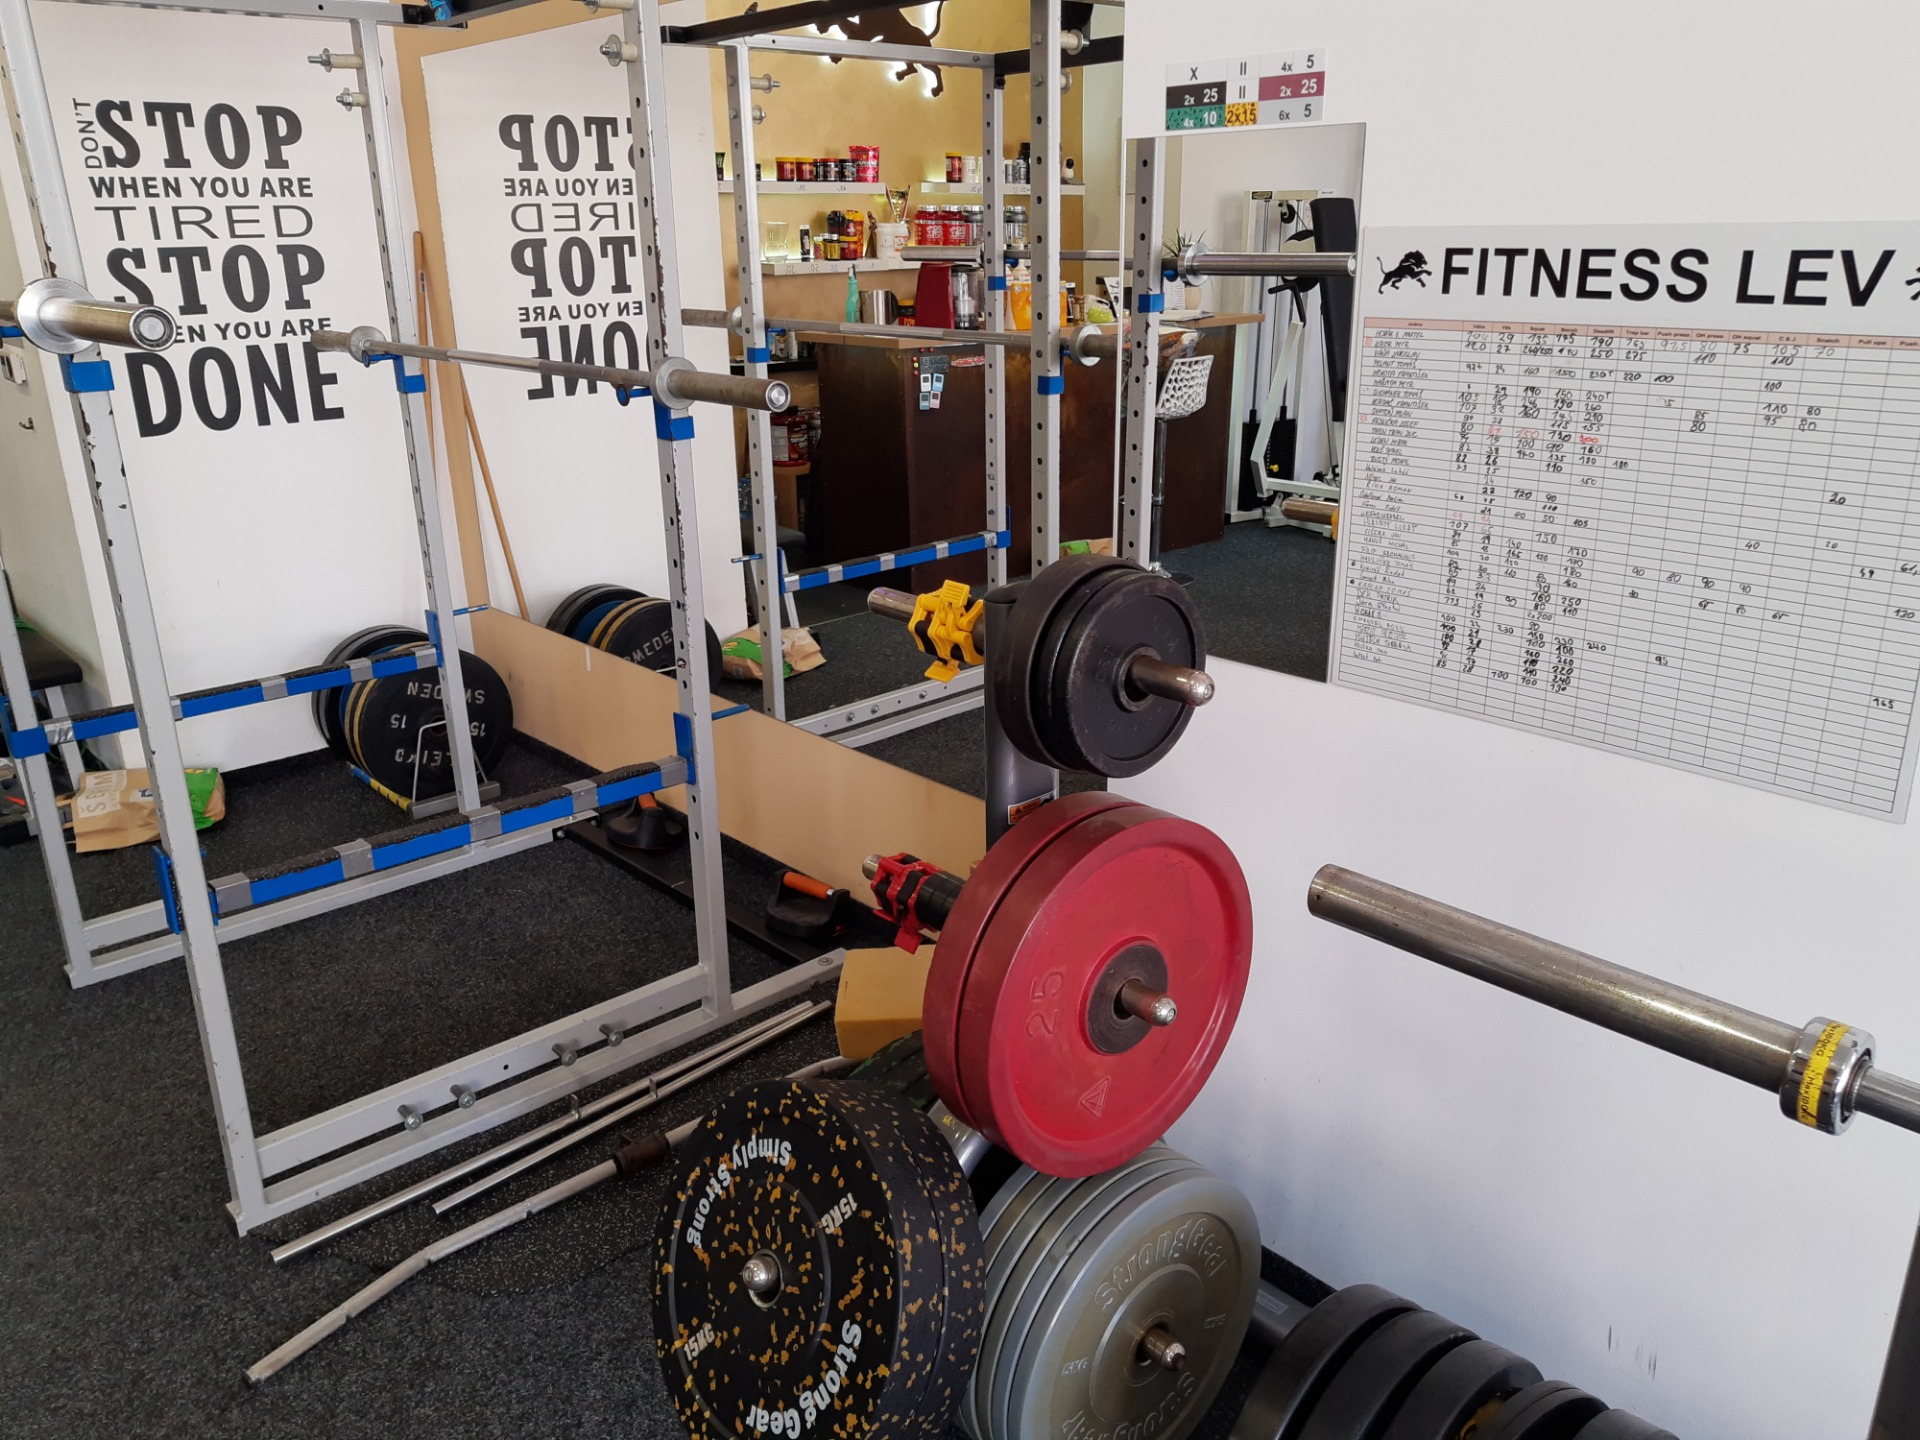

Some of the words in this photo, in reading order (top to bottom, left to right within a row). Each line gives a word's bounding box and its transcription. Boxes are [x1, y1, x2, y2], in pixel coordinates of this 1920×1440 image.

[1281, 62, 1293, 72] 4x
[1306, 54, 1314, 69] 5
[1184, 95, 1195, 106] 2x
[1203, 88, 1218, 103] 25
[1280, 86, 1292, 97] 2x
[1301, 79, 1317, 94] 25
[72, 98, 103, 169] DON'T
[1184, 118, 1194, 128] 4x
[1203, 111, 1217, 125] 10
[1226, 108, 1257, 124] 2x15
[1279, 110, 1290, 121] 6x
[1304, 104, 1312, 118] 5
[95, 99, 302, 169] STOP
[88, 176, 181, 198] WHEN
[190, 177, 249, 198] YOU
[260, 177, 313, 198] ARE
[94, 205, 313, 241] TIRED
[106, 244, 325, 316] STOP
[1440, 247, 1708, 303] FITNESS
[1735, 248, 1897, 308] LEV
[173, 325, 206, 344] EN
[214, 320, 271, 340] YOU
[281, 318, 331, 337] ARE
[1733, 343, 1751, 354] 75
[1625, 351, 1647, 361] 275
[125, 343, 345, 438] DONE
[1623, 372, 1641, 381] 220
[390, 714, 407, 729] 15
[470, 722, 486, 737] 15
[1026, 969, 1065, 1038] 25
[732, 1135, 792, 1170] Simply
[686, 1163, 731, 1247] Strong
[821, 1193, 858, 1234] 15KG
[683, 1323, 717, 1362] 15KG
[799, 1320, 861, 1429] Strong
[745, 1405, 800, 1440] Gear
